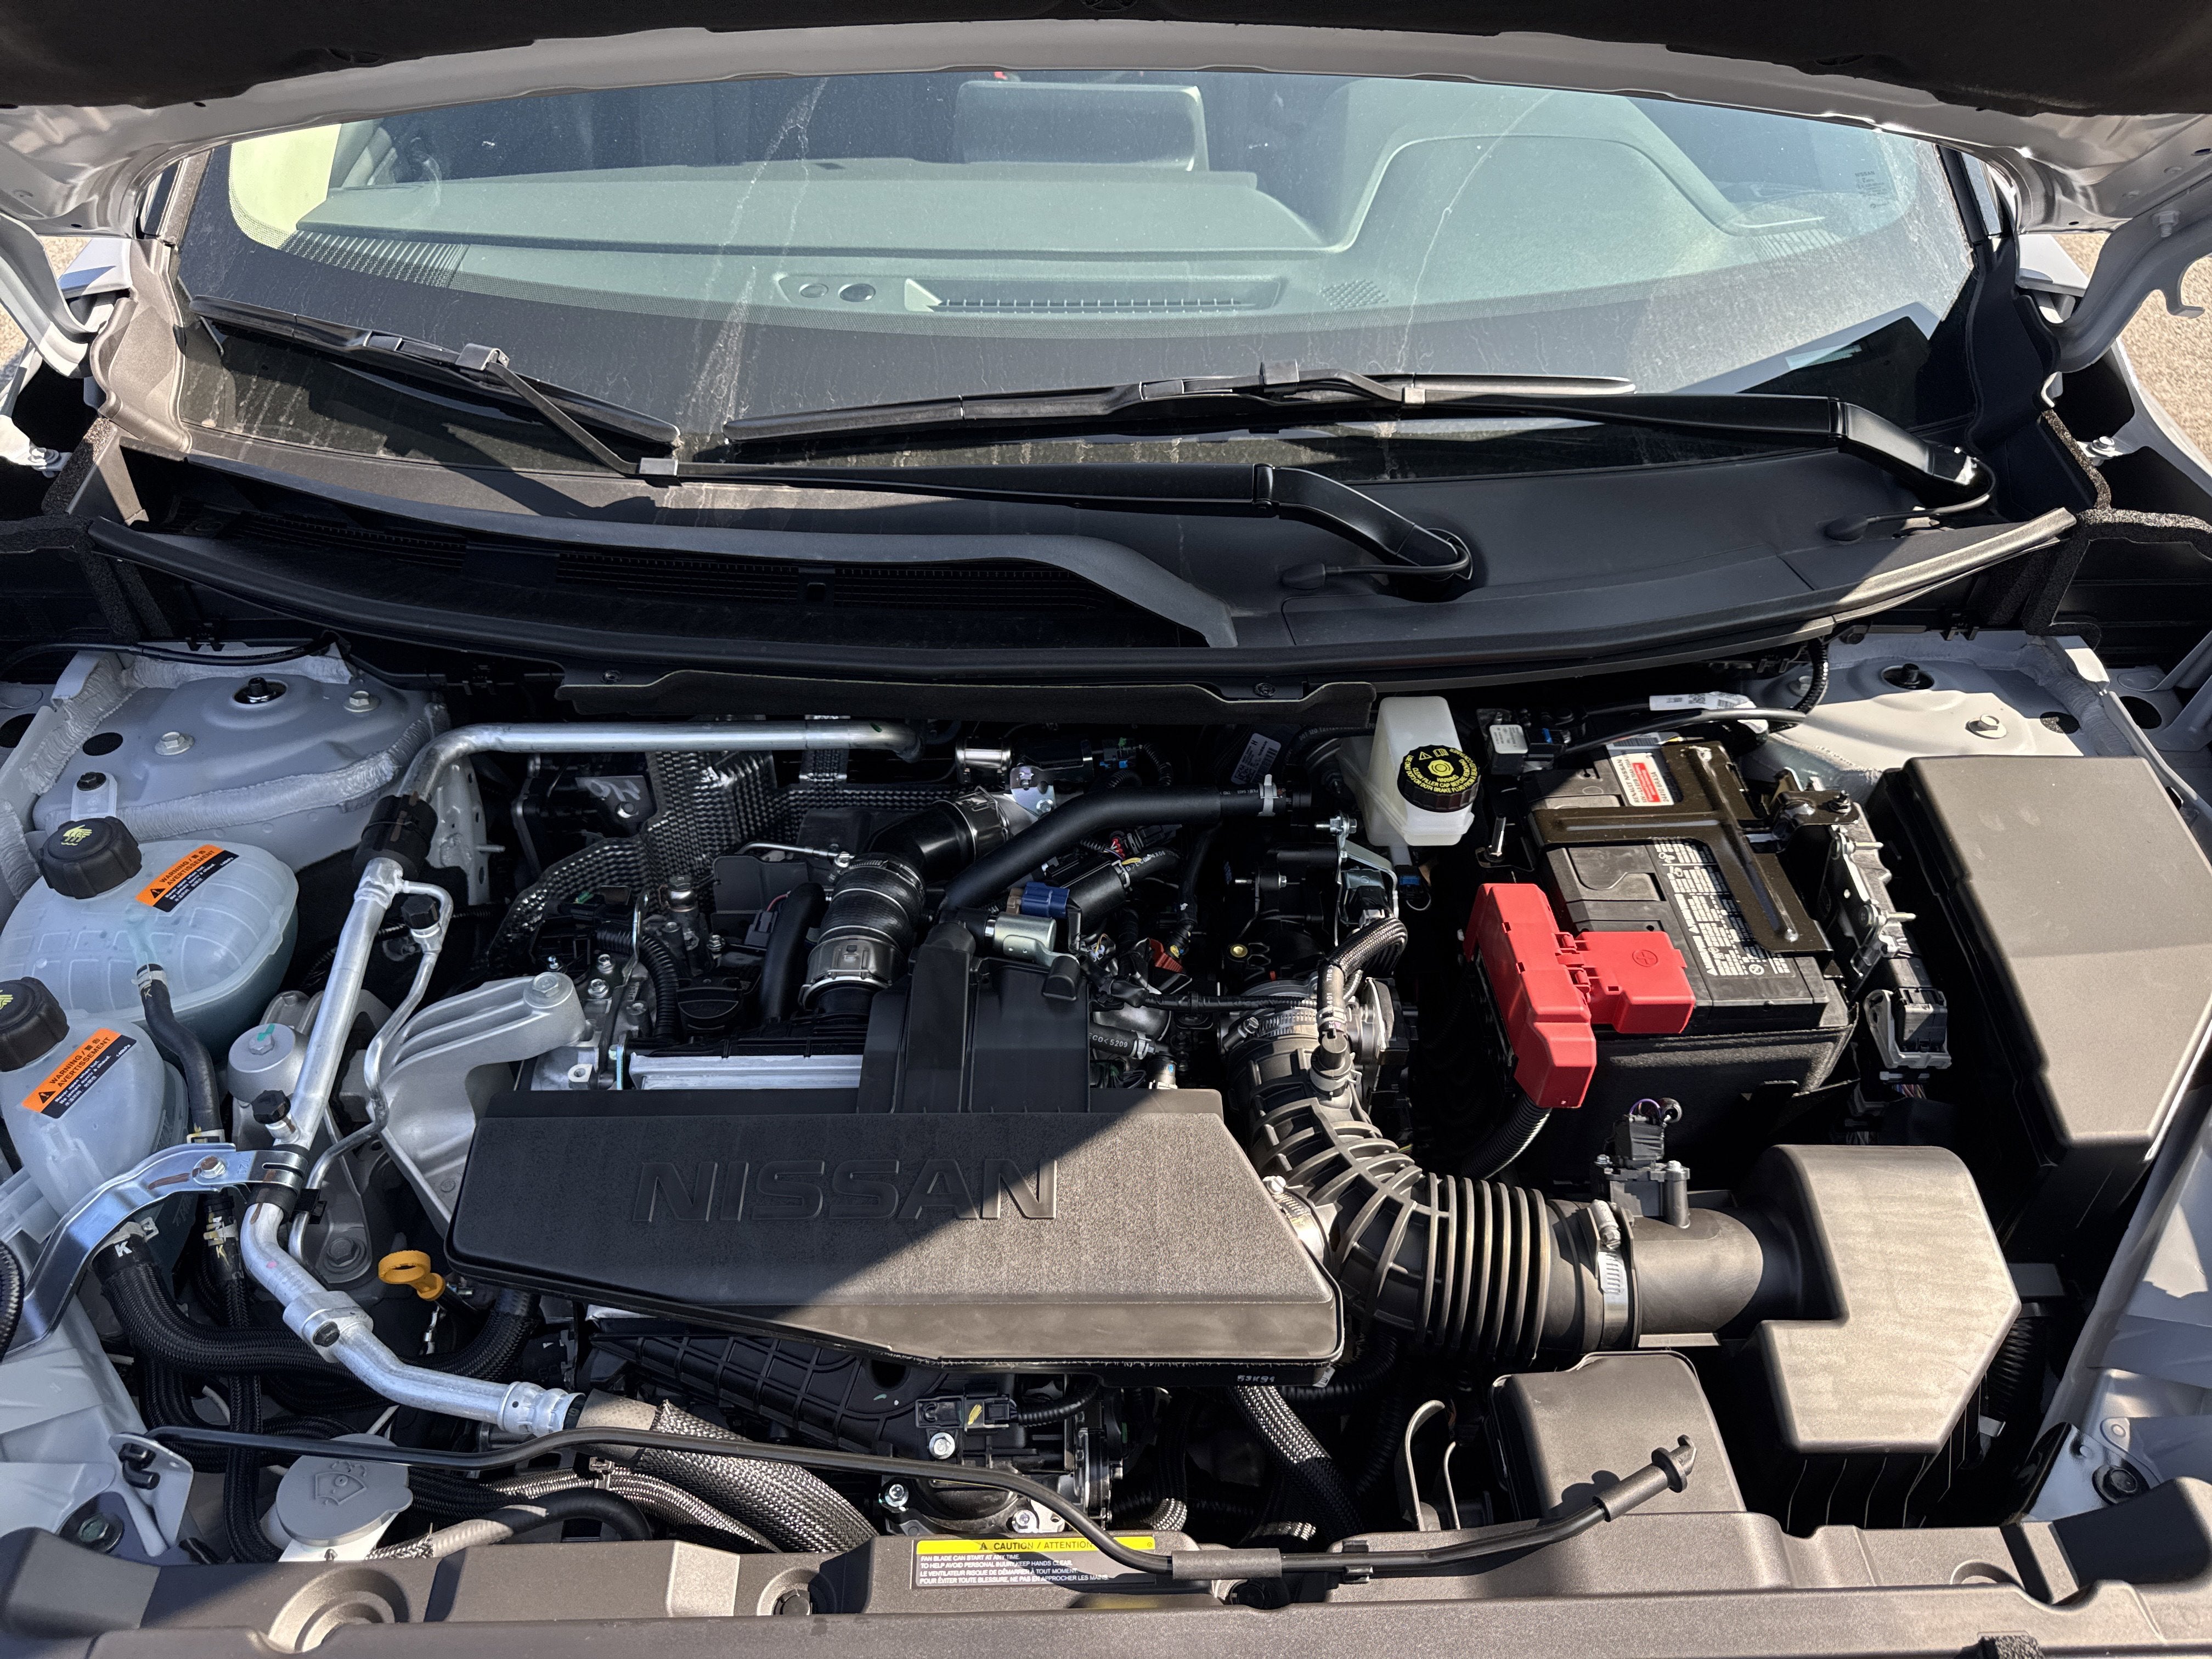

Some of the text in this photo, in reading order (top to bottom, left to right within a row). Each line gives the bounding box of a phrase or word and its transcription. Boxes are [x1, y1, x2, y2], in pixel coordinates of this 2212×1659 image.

[1412, 768, 1425, 779] CLEAN
[1422, 777, 1439, 787] FILLER
[1451, 776, 1469, 786] BEFORE
[1616, 759, 1640, 803] RENAULT NISSAN
[159, 860, 189, 883] WARNING
[167, 849, 215, 886] AVERTISSEMENT
[1110, 1039, 1128, 1047] 5209
[49, 1054, 82, 1084] WARNING
[58, 1037, 111, 1087] AVERTISSEMENT
[634, 1159, 1058, 1221] NISSAN
[115, 1241, 132, 1257] K
